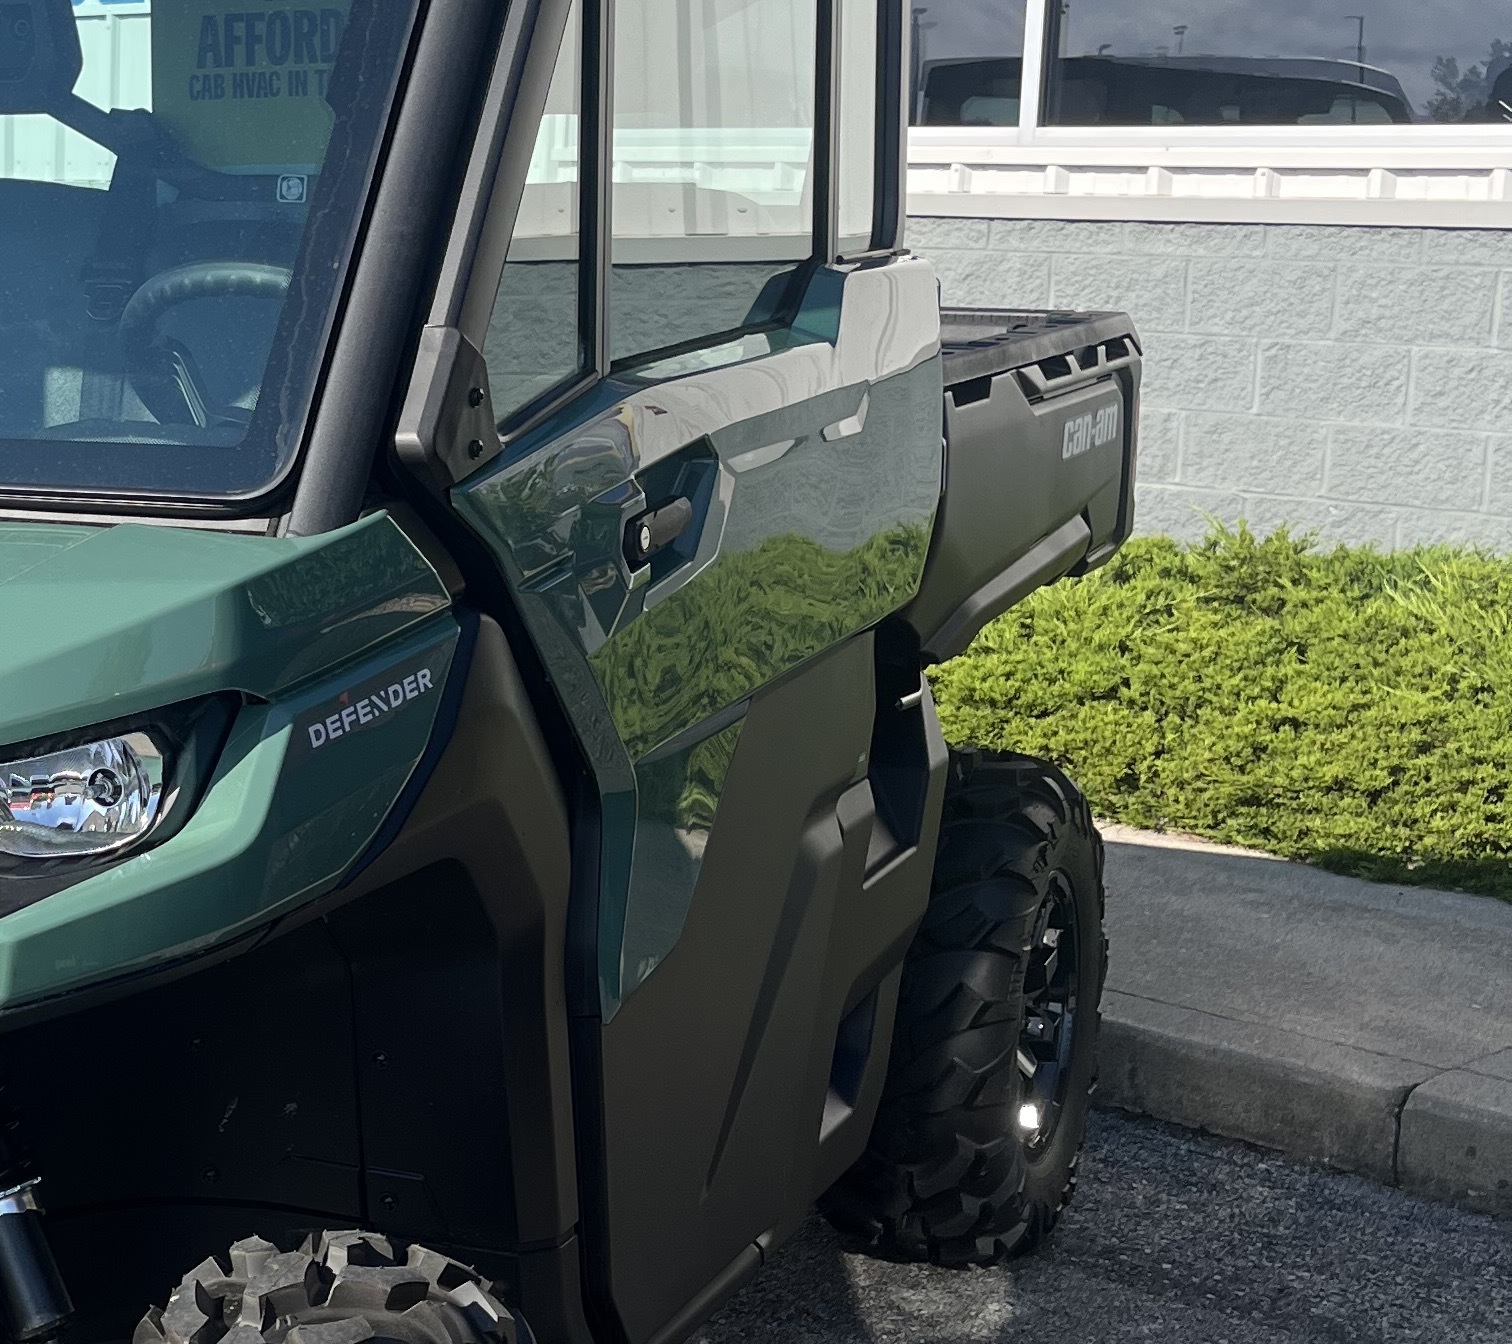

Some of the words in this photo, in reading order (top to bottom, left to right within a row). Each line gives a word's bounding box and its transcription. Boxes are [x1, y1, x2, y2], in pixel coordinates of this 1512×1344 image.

[196, 8, 347, 69] AFFORD
[188, 72, 226, 102] CAB
[232, 70, 282, 100] HVAC
[287, 69, 309, 97] IN
[308, 668, 434, 749] DEFENDER
